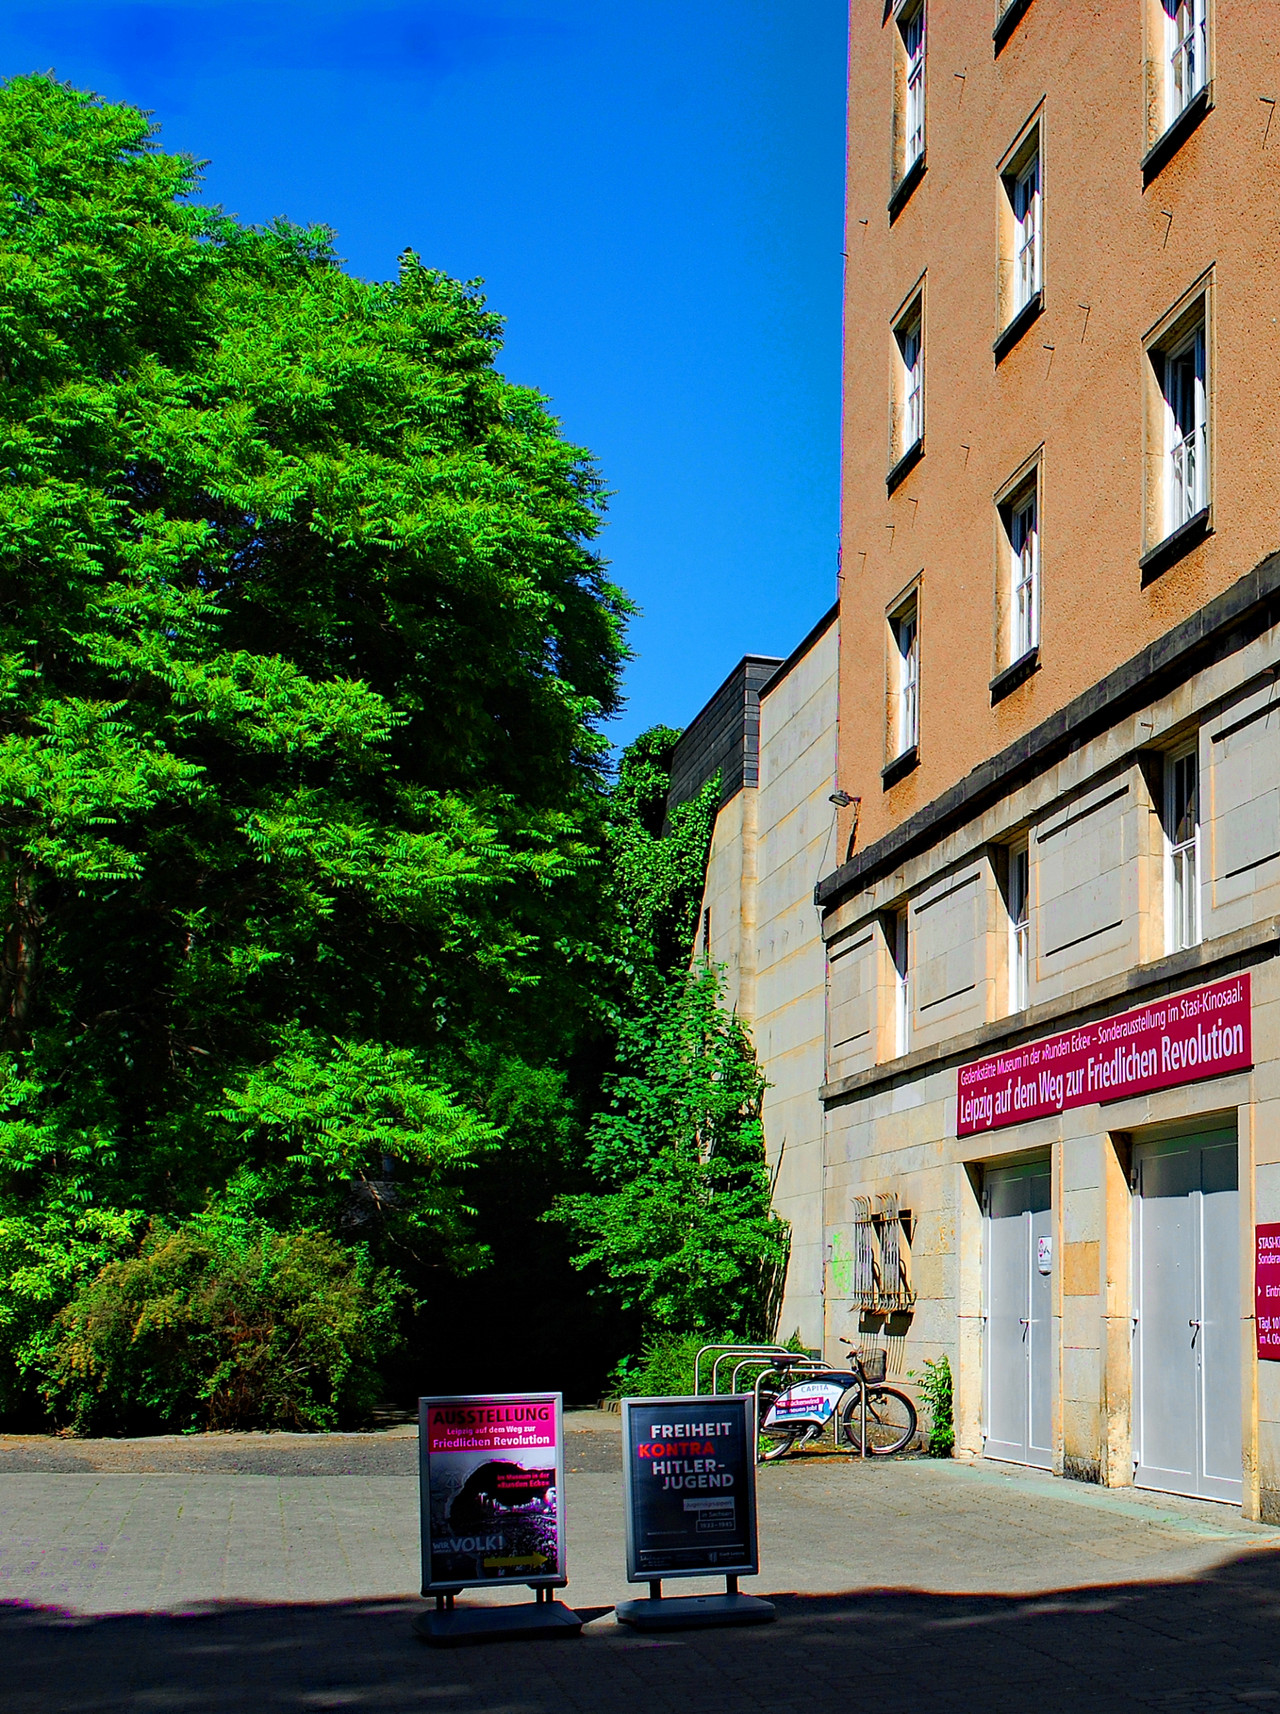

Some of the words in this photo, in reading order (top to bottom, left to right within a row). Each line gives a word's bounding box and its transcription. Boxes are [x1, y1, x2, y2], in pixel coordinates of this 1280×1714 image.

[961, 1063, 996, 1086] Gedenkstätte
[997, 1056, 1022, 1076] Museum
[1022, 1051, 1029, 1067] in
[1030, 1047, 1040, 1065] der
[1098, 1010, 1166, 1044] Sonderausstellung
[1168, 1004, 1179, 1023] im
[1181, 981, 1243, 1019] Stasi-Kinosaal:
[960, 1087, 993, 1129] Leipzig
[995, 1079, 1012, 1115] auf
[1014, 1076, 1037, 1110] dem
[1038, 1070, 1064, 1109] Weg
[1066, 1068, 1085, 1097] zur
[1088, 1042, 1157, 1092] Friedlichen
[1161, 1018, 1244, 1073] Revolution
[1258, 1332, 1267, 1344] im
[801, 1384, 829, 1392] CAPITA
[433, 1406, 550, 1425] AUSSTELLUNG
[446, 1427, 474, 1436] Leipzig
[475, 1426, 488, 1434] auf
[488, 1425, 506, 1434] dem
[506, 1425, 523, 1435] Weg
[523, 1425, 536, 1433] zur
[650, 1421, 733, 1439] FREIHEIT
[432, 1436, 491, 1449] Friedlichen
[493, 1434, 551, 1447] Revolution
[637, 1440, 716, 1459] KONTRA
[651, 1458, 726, 1476] HITLER-
[661, 1473, 735, 1491] JUGEND
[449, 1535, 504, 1553] VOLK!
